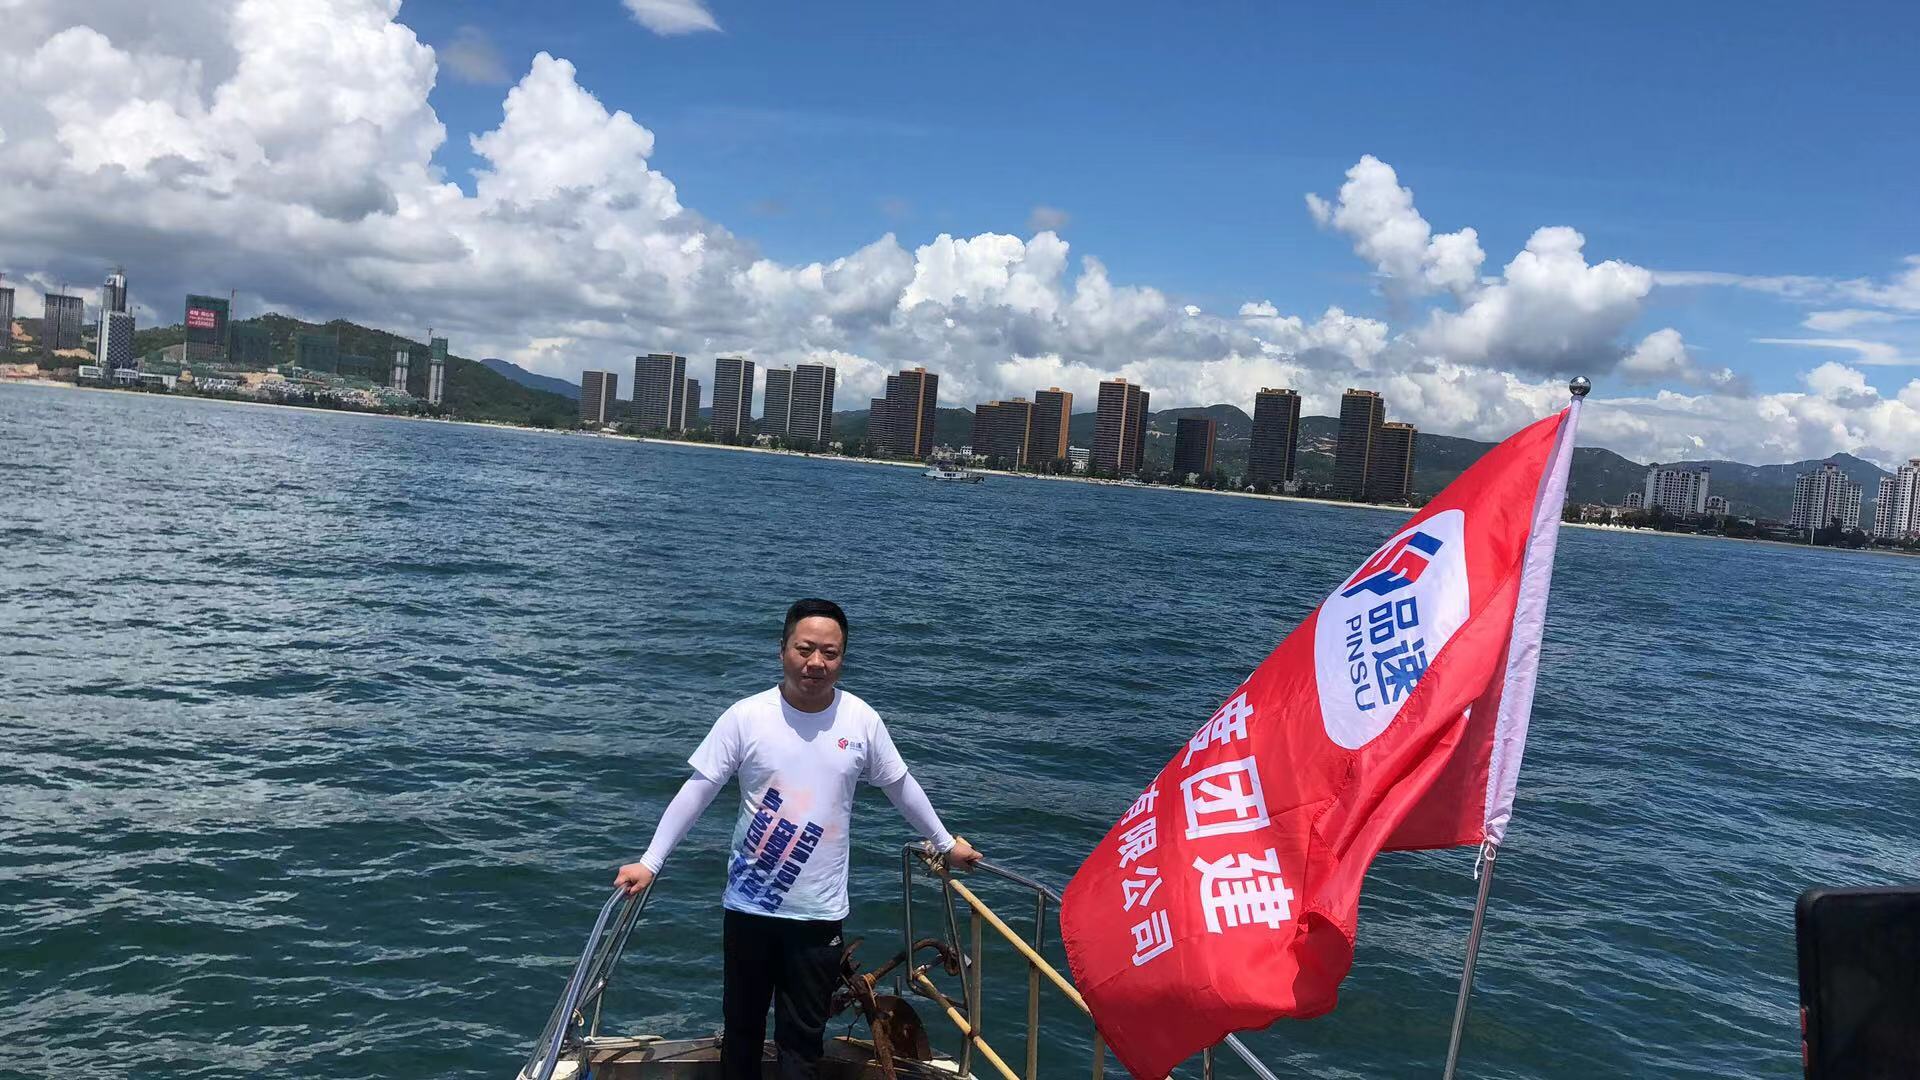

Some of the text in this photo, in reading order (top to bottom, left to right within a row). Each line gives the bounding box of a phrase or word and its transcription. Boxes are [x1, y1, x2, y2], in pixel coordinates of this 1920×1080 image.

[1345, 614, 1376, 712] PINSU
[1368, 596, 1430, 706] 品速
[762, 787, 783, 813] UP
[1180, 671, 1295, 934] 度团建
[738, 869, 766, 900] TRY
[755, 817, 799, 875] HARDER
[759, 821, 825, 914] AS YOU WISH
[1117, 774, 1174, 967] 有限公司
